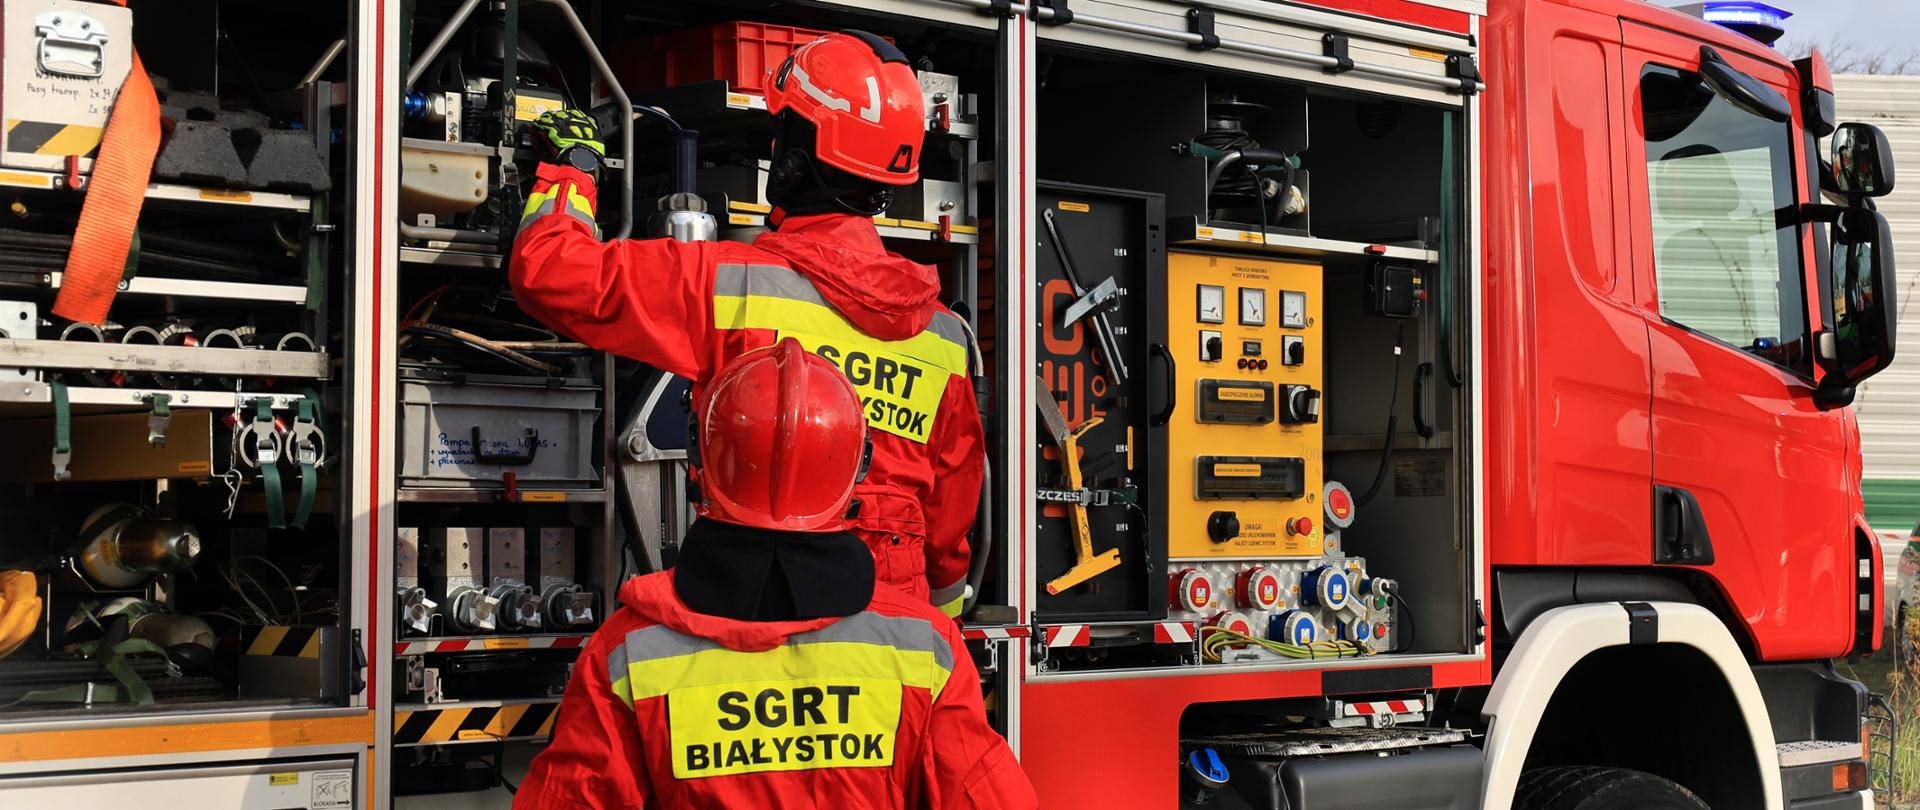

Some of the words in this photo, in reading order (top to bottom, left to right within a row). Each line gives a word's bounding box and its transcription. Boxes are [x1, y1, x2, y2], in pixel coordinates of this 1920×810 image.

[816, 344, 923, 400] SGRT
[518, 438, 548, 449] LUAS
[717, 685, 860, 731] SGRT
[686, 733, 884, 771] BIAŁYSTOK
